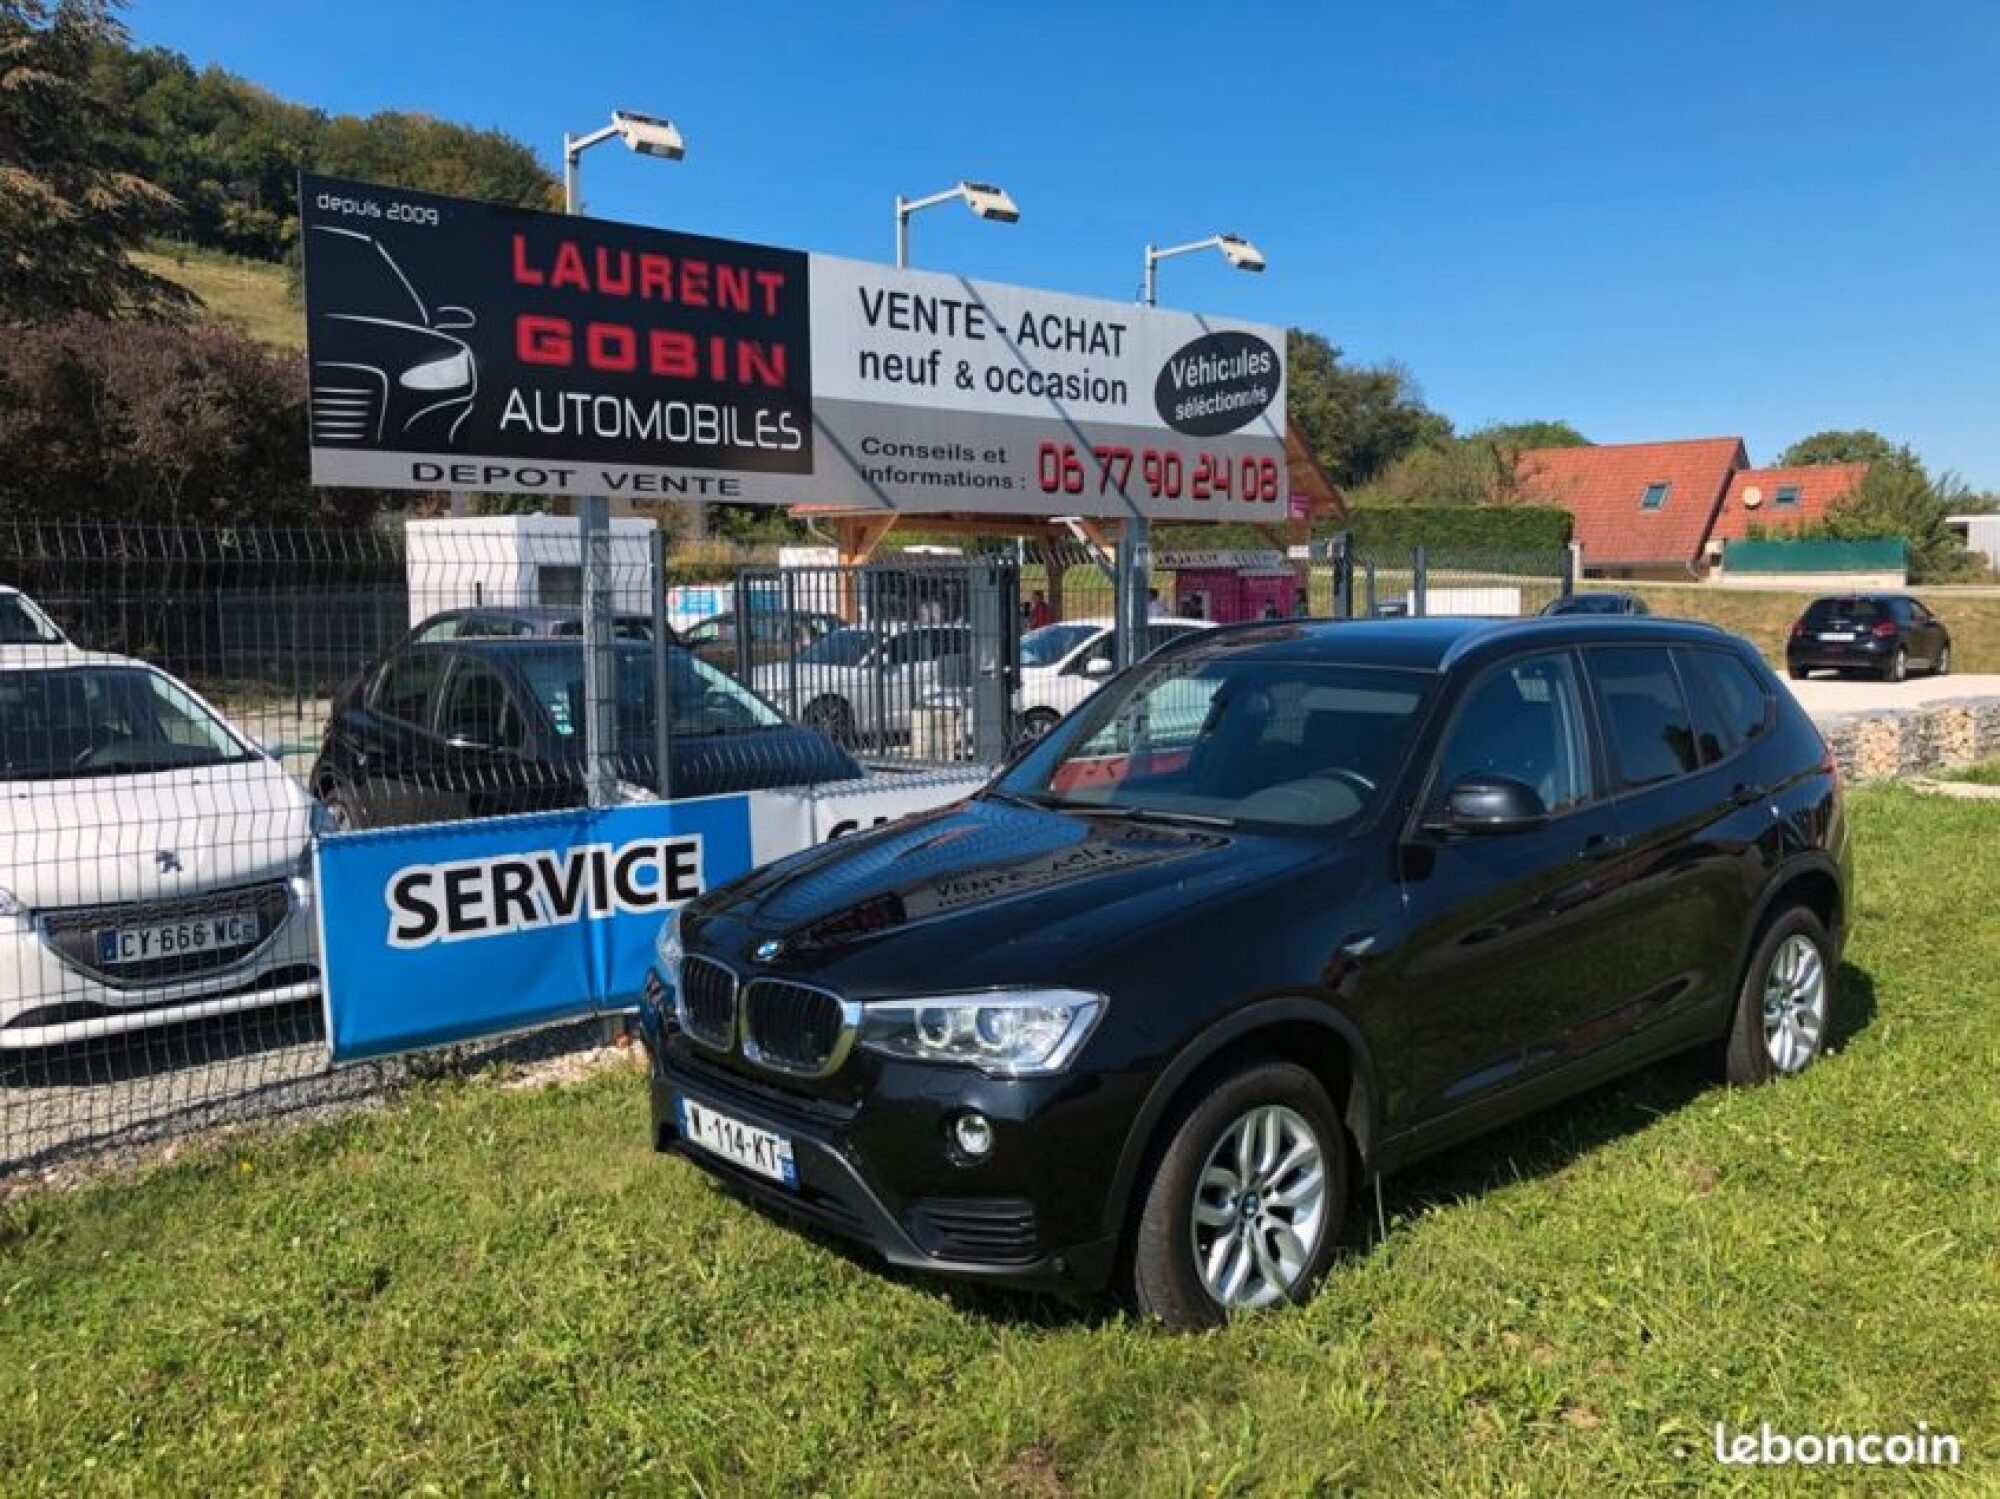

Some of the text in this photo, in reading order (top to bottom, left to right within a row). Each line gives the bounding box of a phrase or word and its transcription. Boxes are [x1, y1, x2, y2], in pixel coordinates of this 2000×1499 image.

[316, 192, 440, 226] depuis 2009
[511, 233, 785, 316] LAURENT
[515, 314, 785, 388] GOBIN
[858, 285, 986, 340] VENTE
[1016, 310, 1127, 357] ACHAT
[858, 347, 1127, 405] neuf & occasion
[1170, 346, 1271, 391] Véhicules
[500, 387, 801, 451] AUTOMOBILES
[412, 462, 742, 497] DEPOT VENTE
[861, 437, 1007, 464] Conseils et
[861, 464, 1014, 489] informations
[1038, 441, 1279, 503] 06 77 90 24 08
[391, 840, 700, 941] SERVICE
